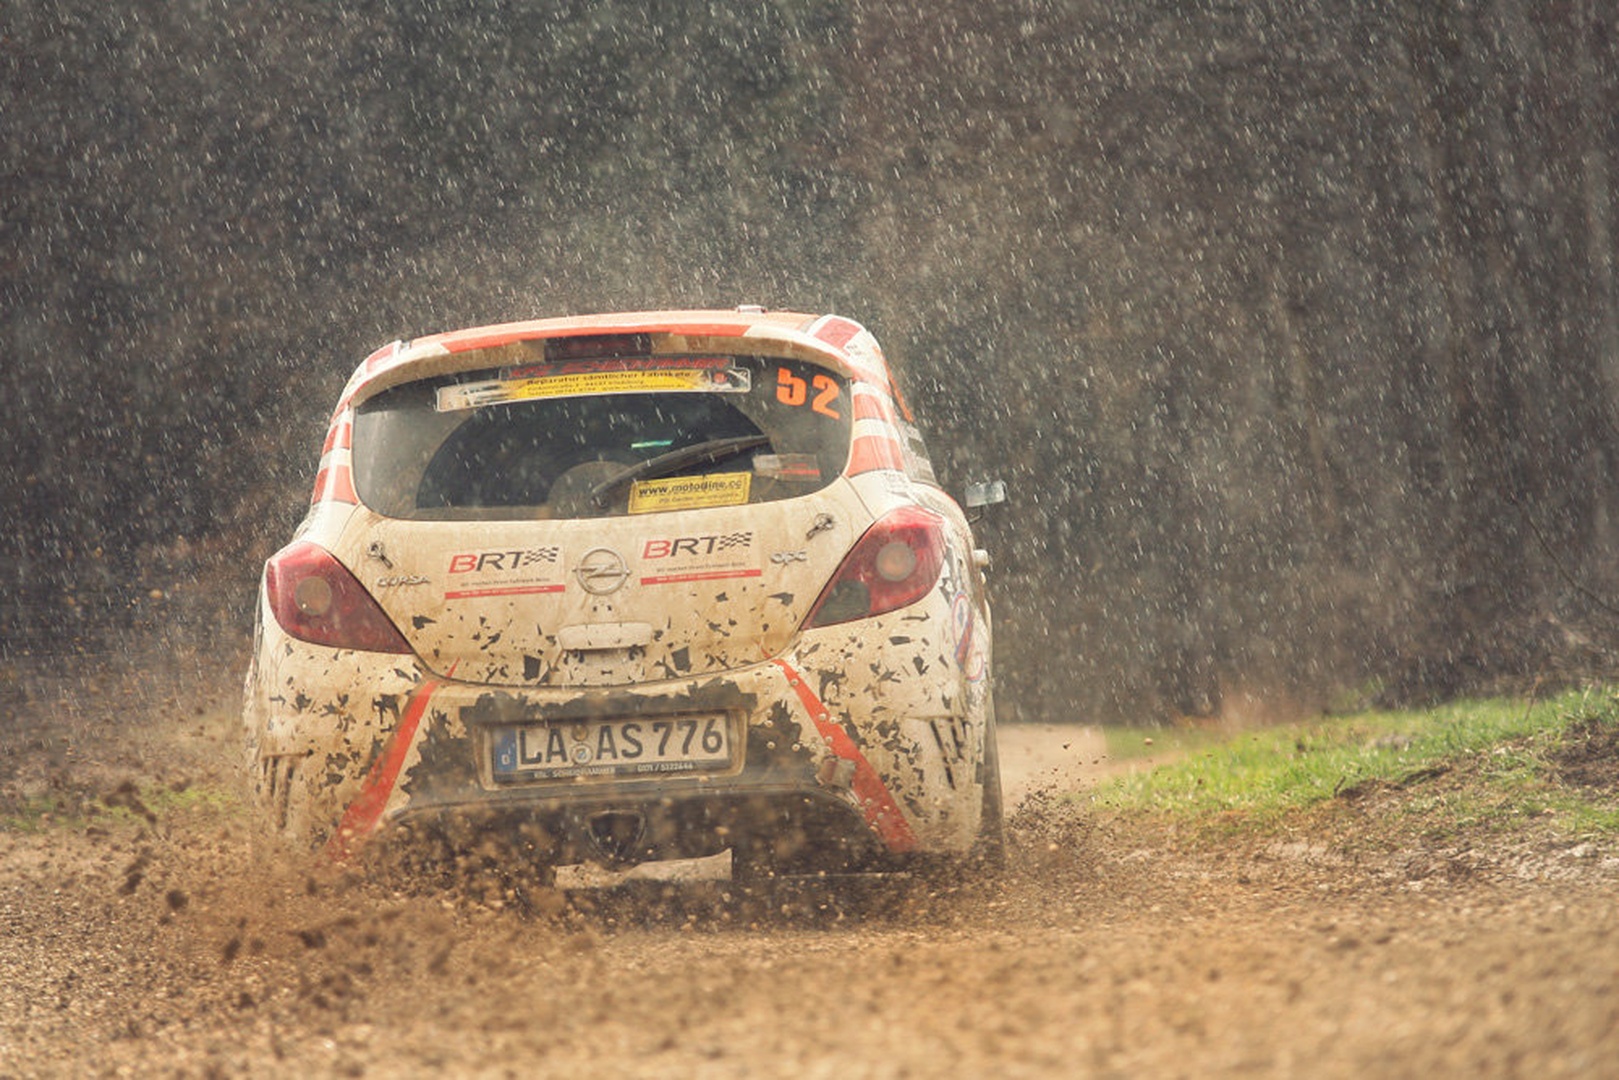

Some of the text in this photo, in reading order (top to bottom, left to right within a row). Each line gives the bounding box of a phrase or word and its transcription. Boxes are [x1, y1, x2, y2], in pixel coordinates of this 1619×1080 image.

[776, 366, 840, 420] 52
[449, 551, 525, 574] BRT
[643, 535, 719, 560] BRT
[520, 728, 568, 765] LA
